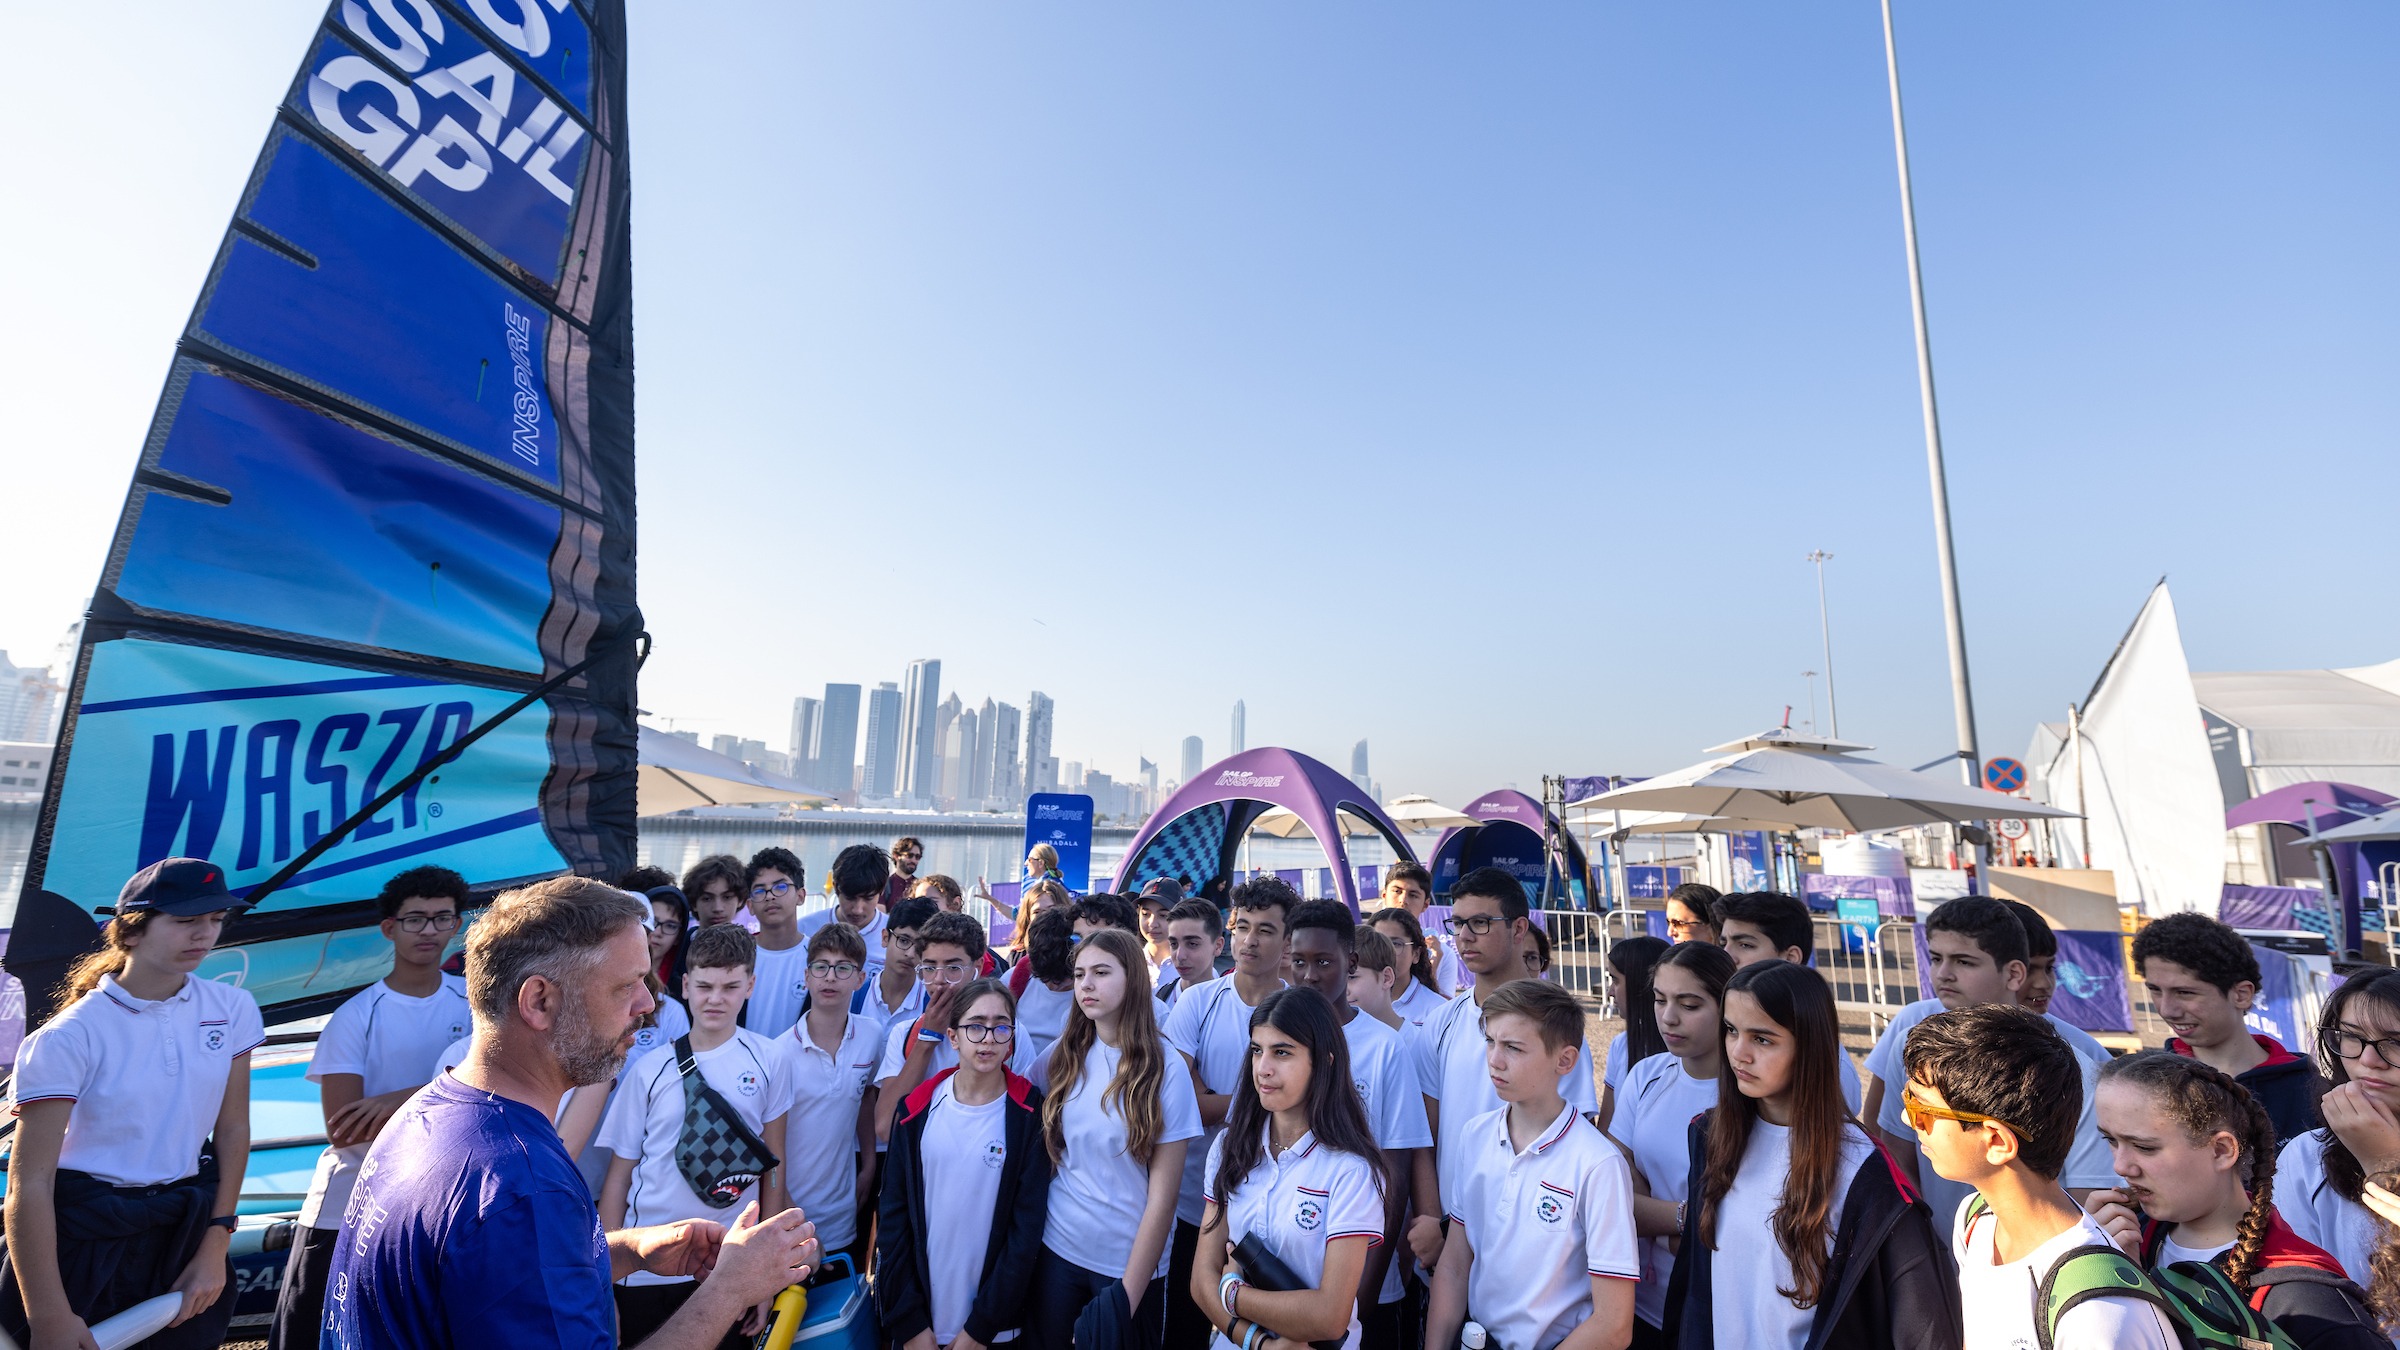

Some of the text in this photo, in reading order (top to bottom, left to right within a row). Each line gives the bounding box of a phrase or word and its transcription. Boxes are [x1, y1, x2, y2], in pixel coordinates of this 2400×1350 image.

[308, 55, 493, 192] GP
[342, 0, 585, 206] SAIL
[505, 302, 541, 466] INSPIRE
[137, 700, 474, 872] WASZP
[1215, 775, 1284, 787] INSPIRE
[2004, 821, 2021, 831] 30
